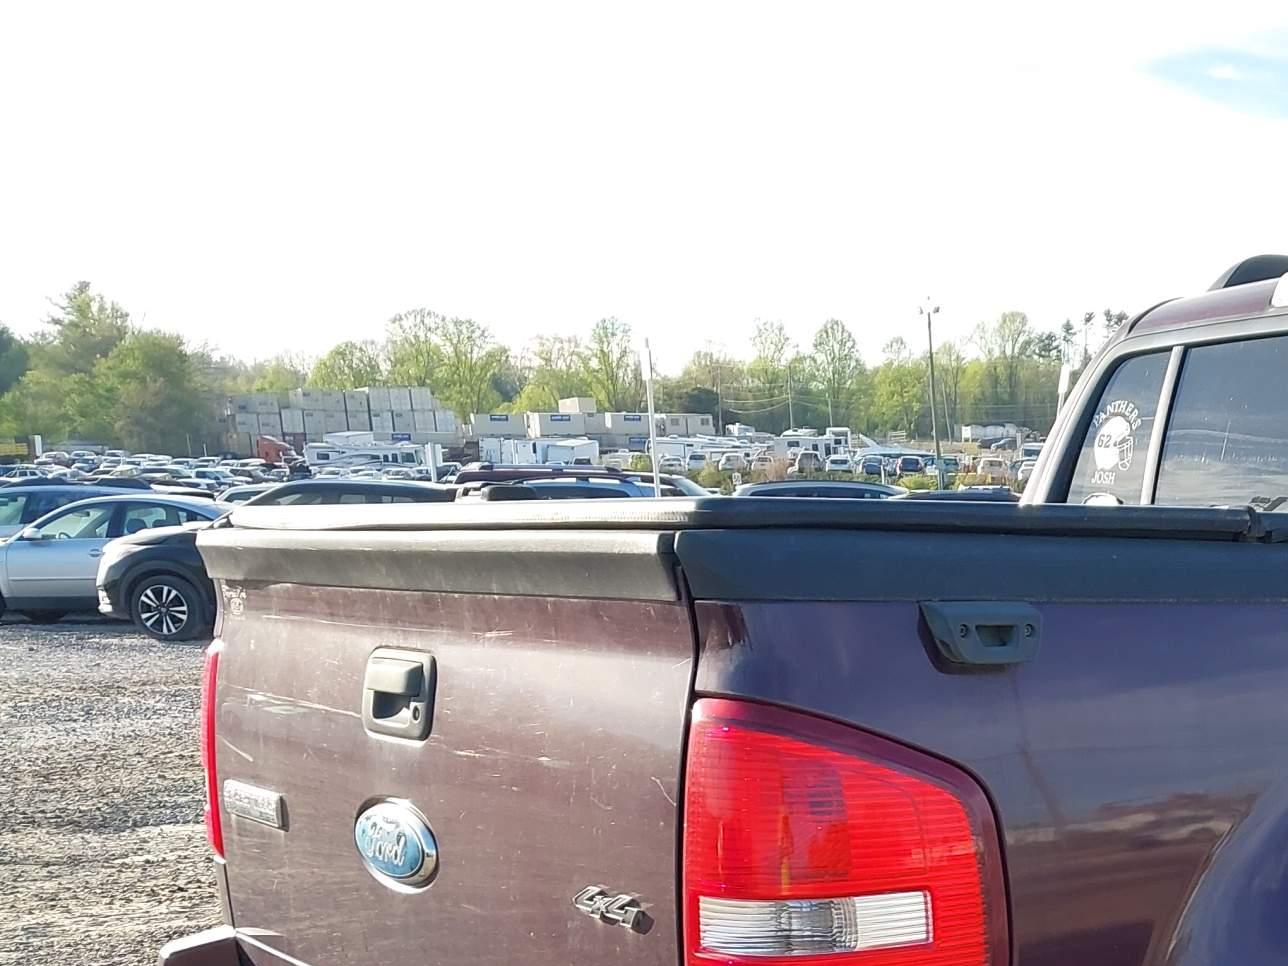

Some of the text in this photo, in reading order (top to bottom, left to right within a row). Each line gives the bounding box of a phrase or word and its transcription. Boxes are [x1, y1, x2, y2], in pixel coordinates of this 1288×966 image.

[1092, 399, 1142, 431] PANTHERS
[1097, 434, 1112, 449] 62
[1091, 470, 1116, 485] JOSH
[364, 820, 407, 867] Ford
